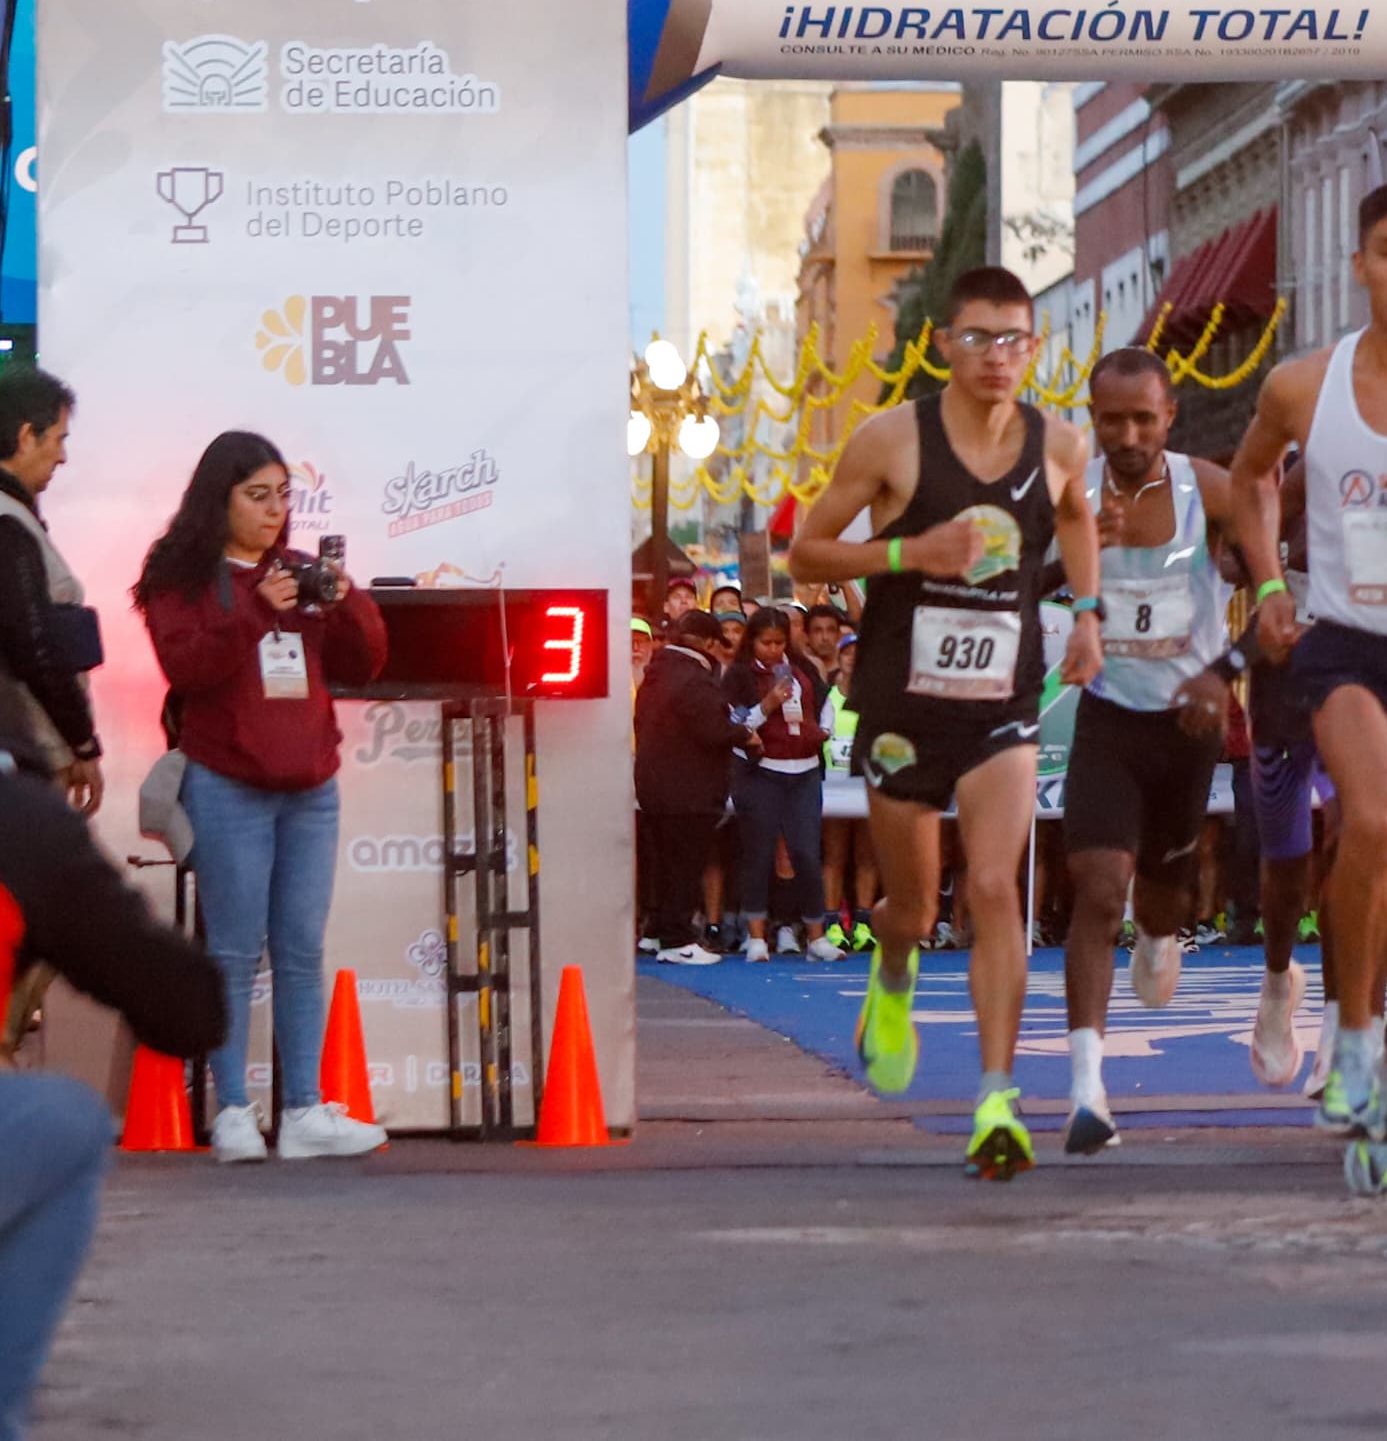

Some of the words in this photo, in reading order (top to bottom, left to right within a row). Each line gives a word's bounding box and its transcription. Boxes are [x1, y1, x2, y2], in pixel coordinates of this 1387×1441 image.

[1188, 8, 1370, 41] TOTAL!
[286, 46, 445, 75] Secretaría
[780, 44, 867, 55] CONSULTE
[871, 44, 882, 55] A
[286, 82, 326, 107] de
[335, 80, 496, 108] Educación
[246, 182, 376, 207] Instituto
[386, 181, 509, 207] Poblano
[246, 213, 289, 238] del
[301, 213, 424, 243] Deporte
[311, 295, 411, 341] PUE
[311, 340, 411, 386] BLA
[382, 448, 500, 519] Skarch
[1136, 603, 1151, 634] 8
[541, 606, 584, 682] 3
[936, 634, 995, 670] 930
